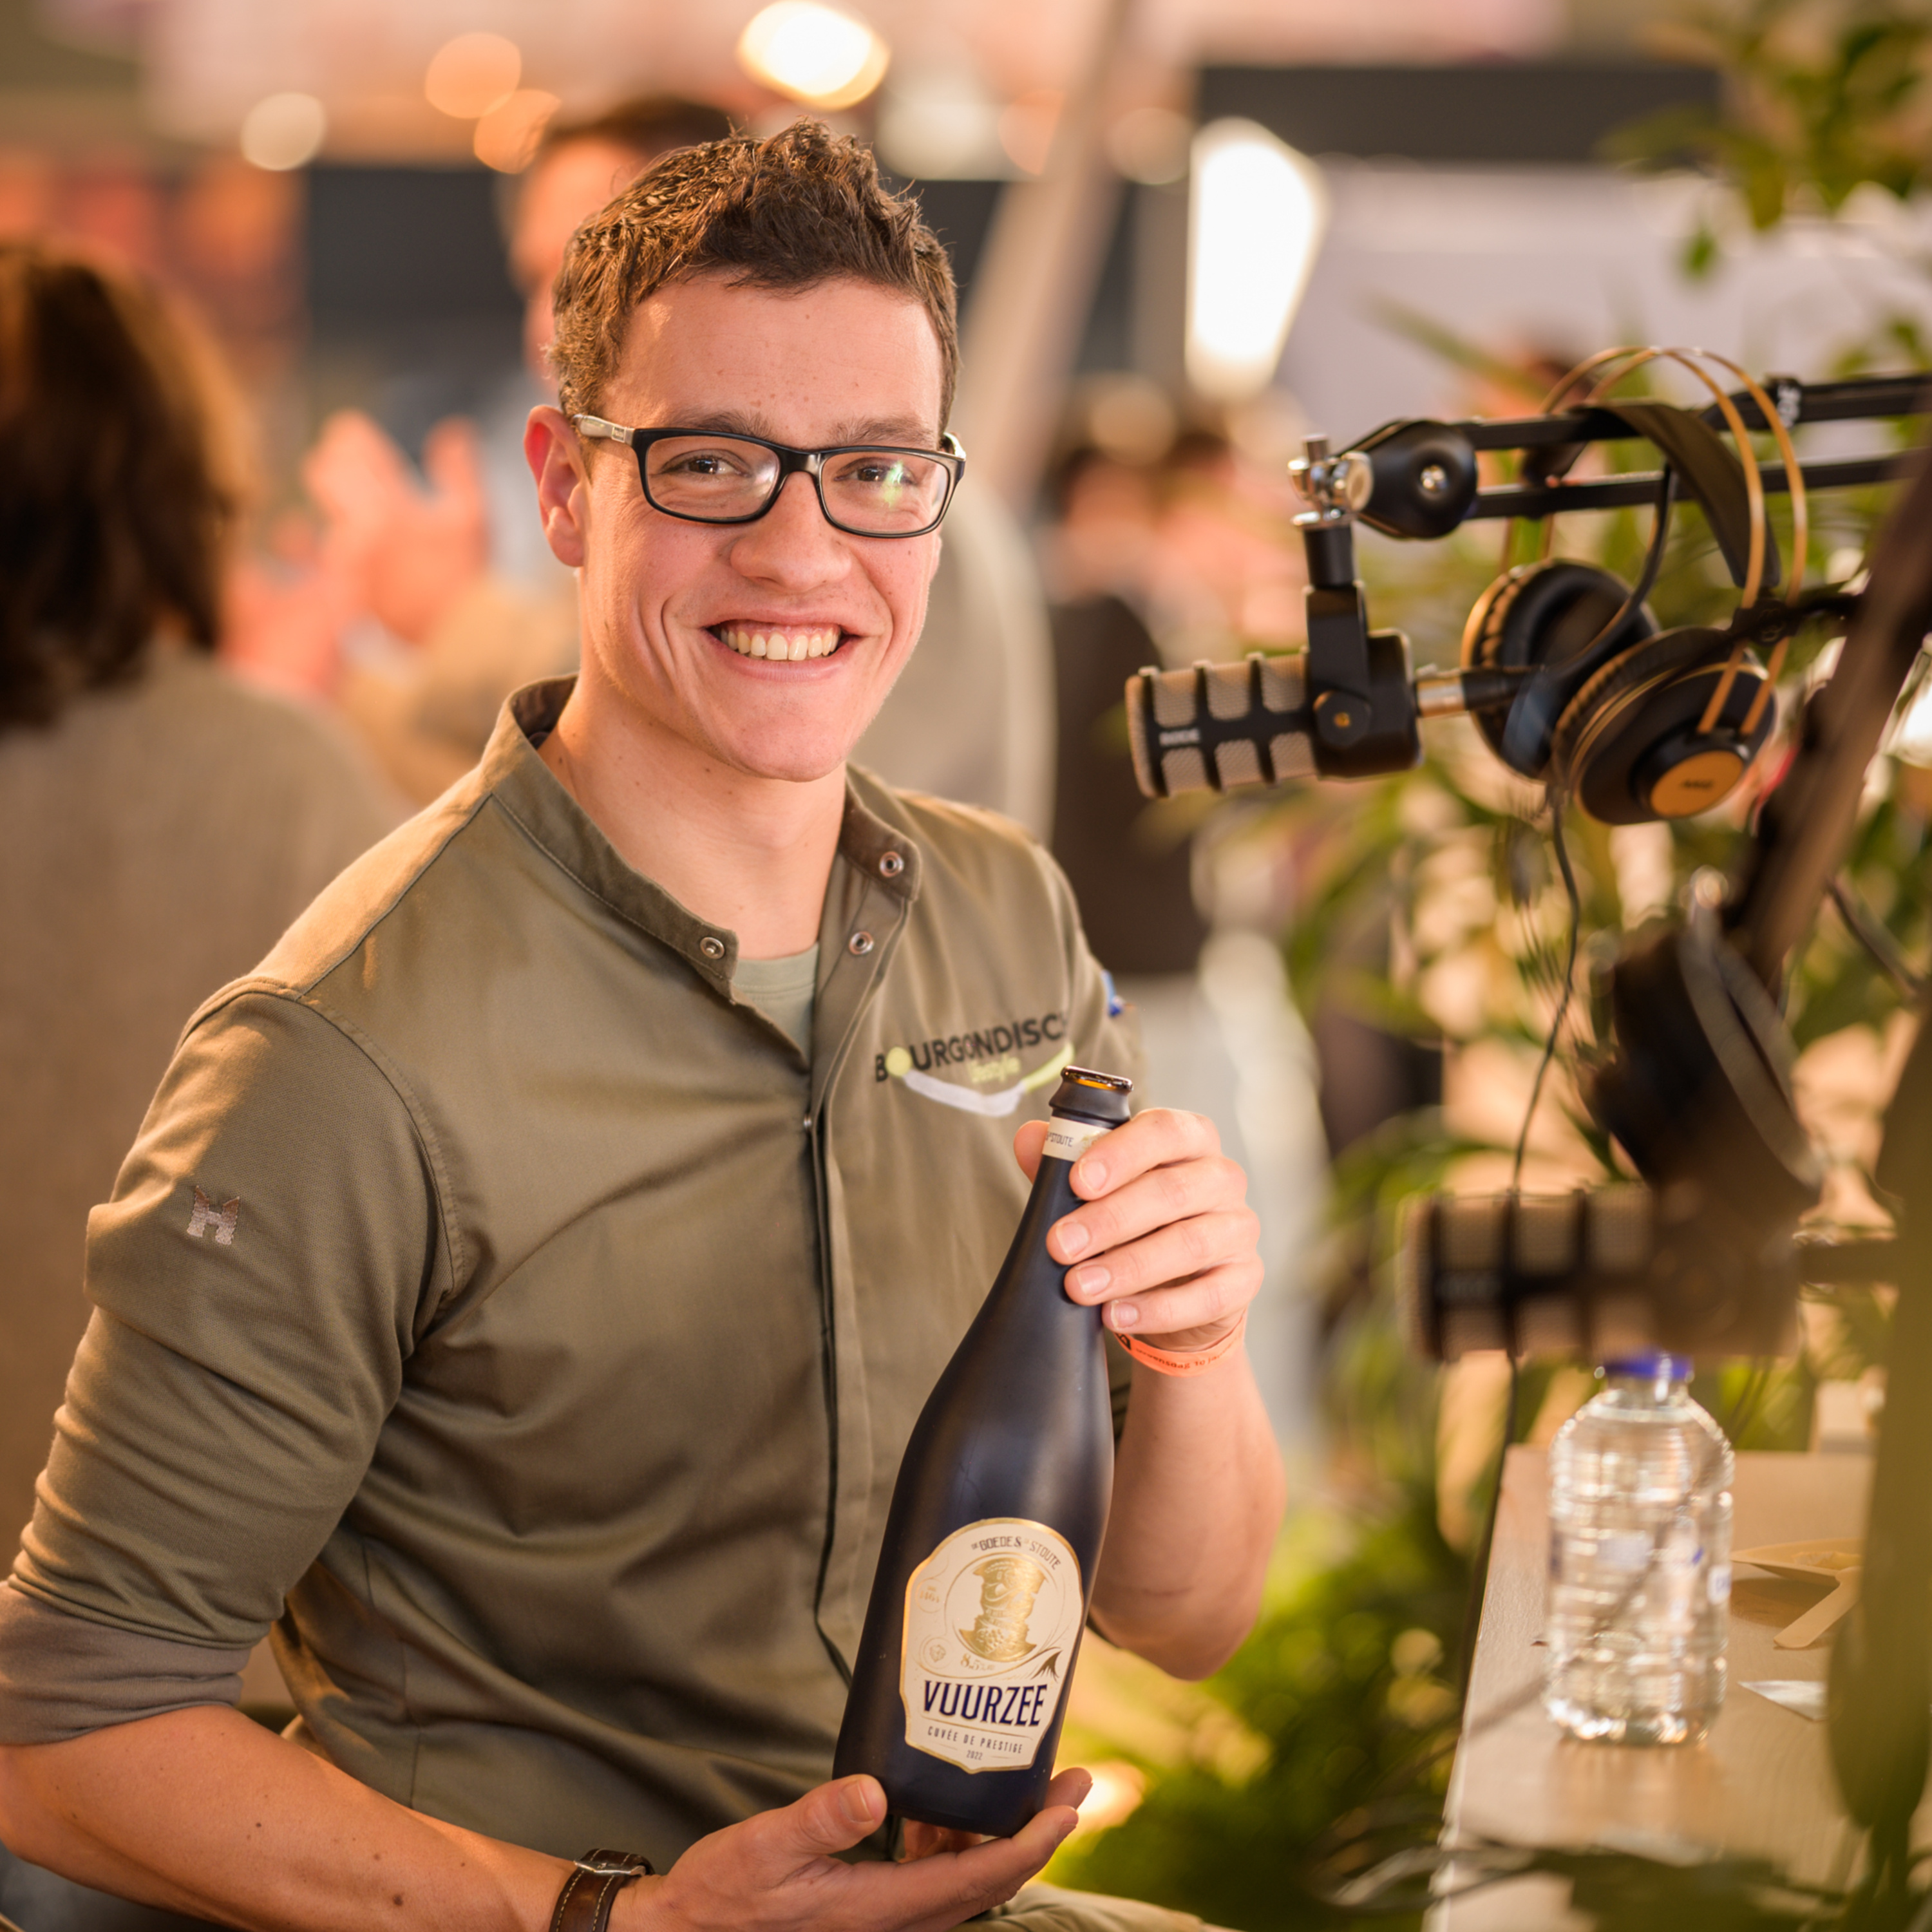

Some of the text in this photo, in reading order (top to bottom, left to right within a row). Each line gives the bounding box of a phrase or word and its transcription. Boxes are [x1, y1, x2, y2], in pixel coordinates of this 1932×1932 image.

[1051, 1133, 1074, 1147] STOUTE
[979, 1536, 1012, 1551] GOEDE
[1029, 1540, 1061, 1570] STOUTE
[923, 1680, 1048, 1727] VUURZEE
[928, 1725, 1023, 1754] CUVÉE DE PRESTIGE
[967, 1749, 983, 1761] 2022
